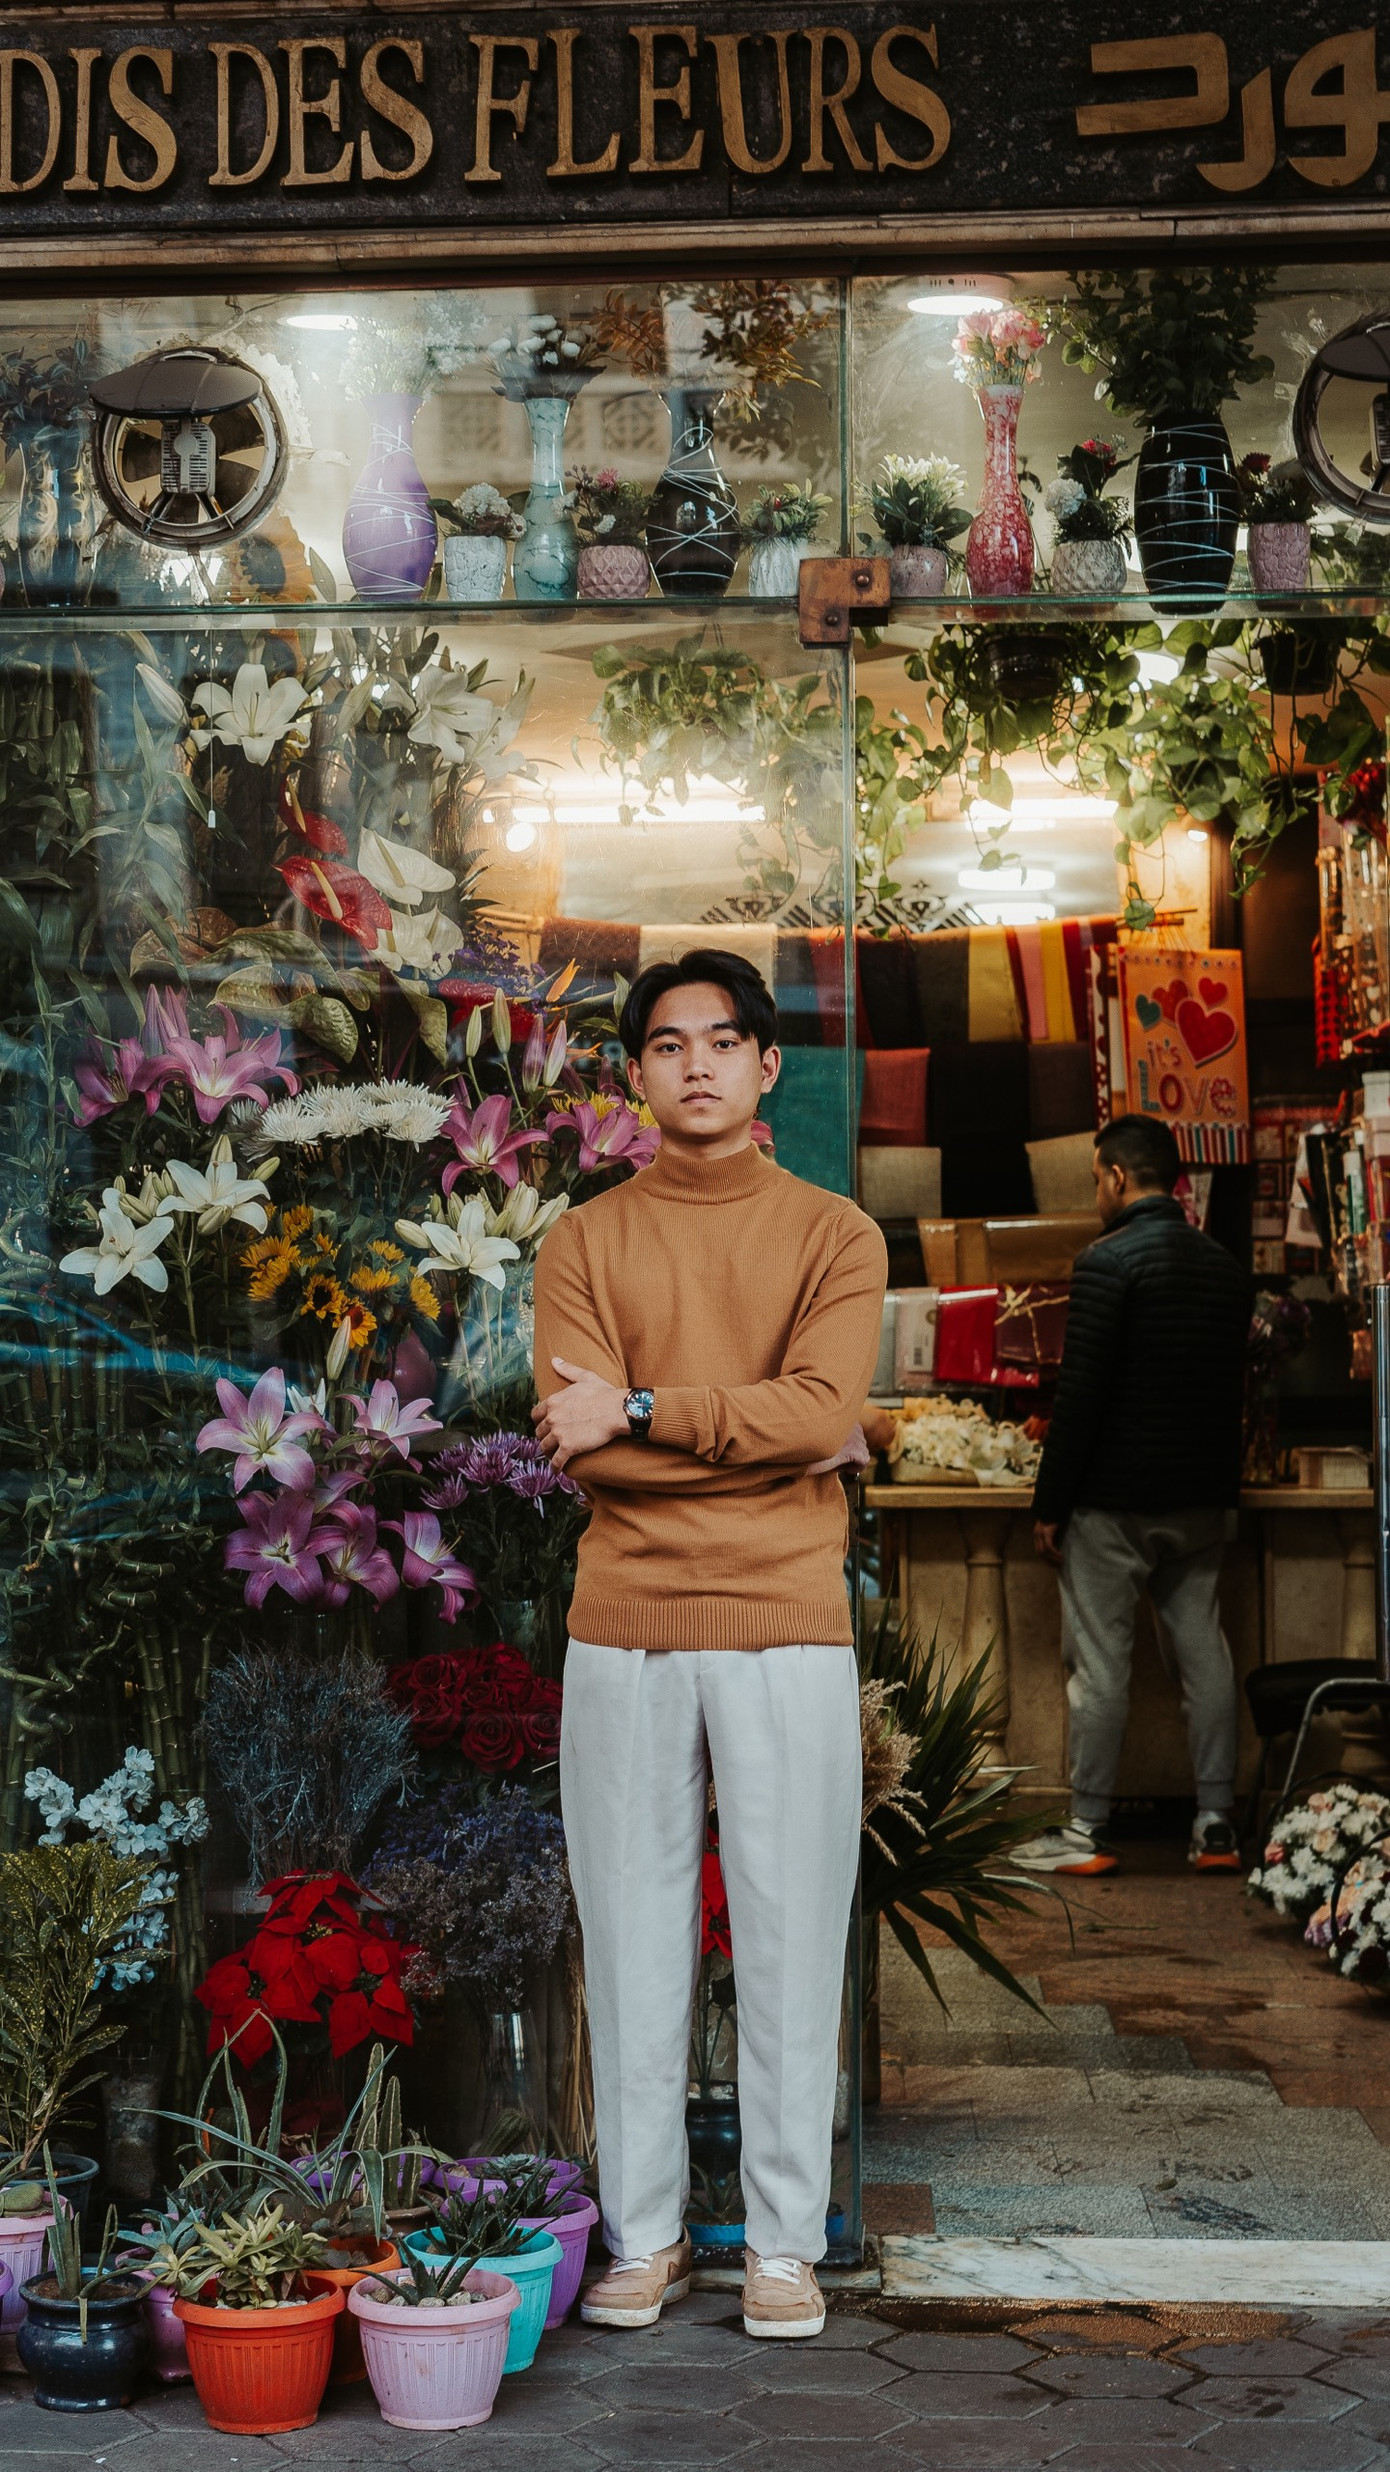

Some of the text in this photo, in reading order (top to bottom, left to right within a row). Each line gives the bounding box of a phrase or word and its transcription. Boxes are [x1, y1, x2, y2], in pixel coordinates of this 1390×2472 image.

[0, 24, 951, 193] DIS DES FLEURS
[1077, 28, 1390, 191] ورد
[1147, 1038, 1182, 1069] it's
